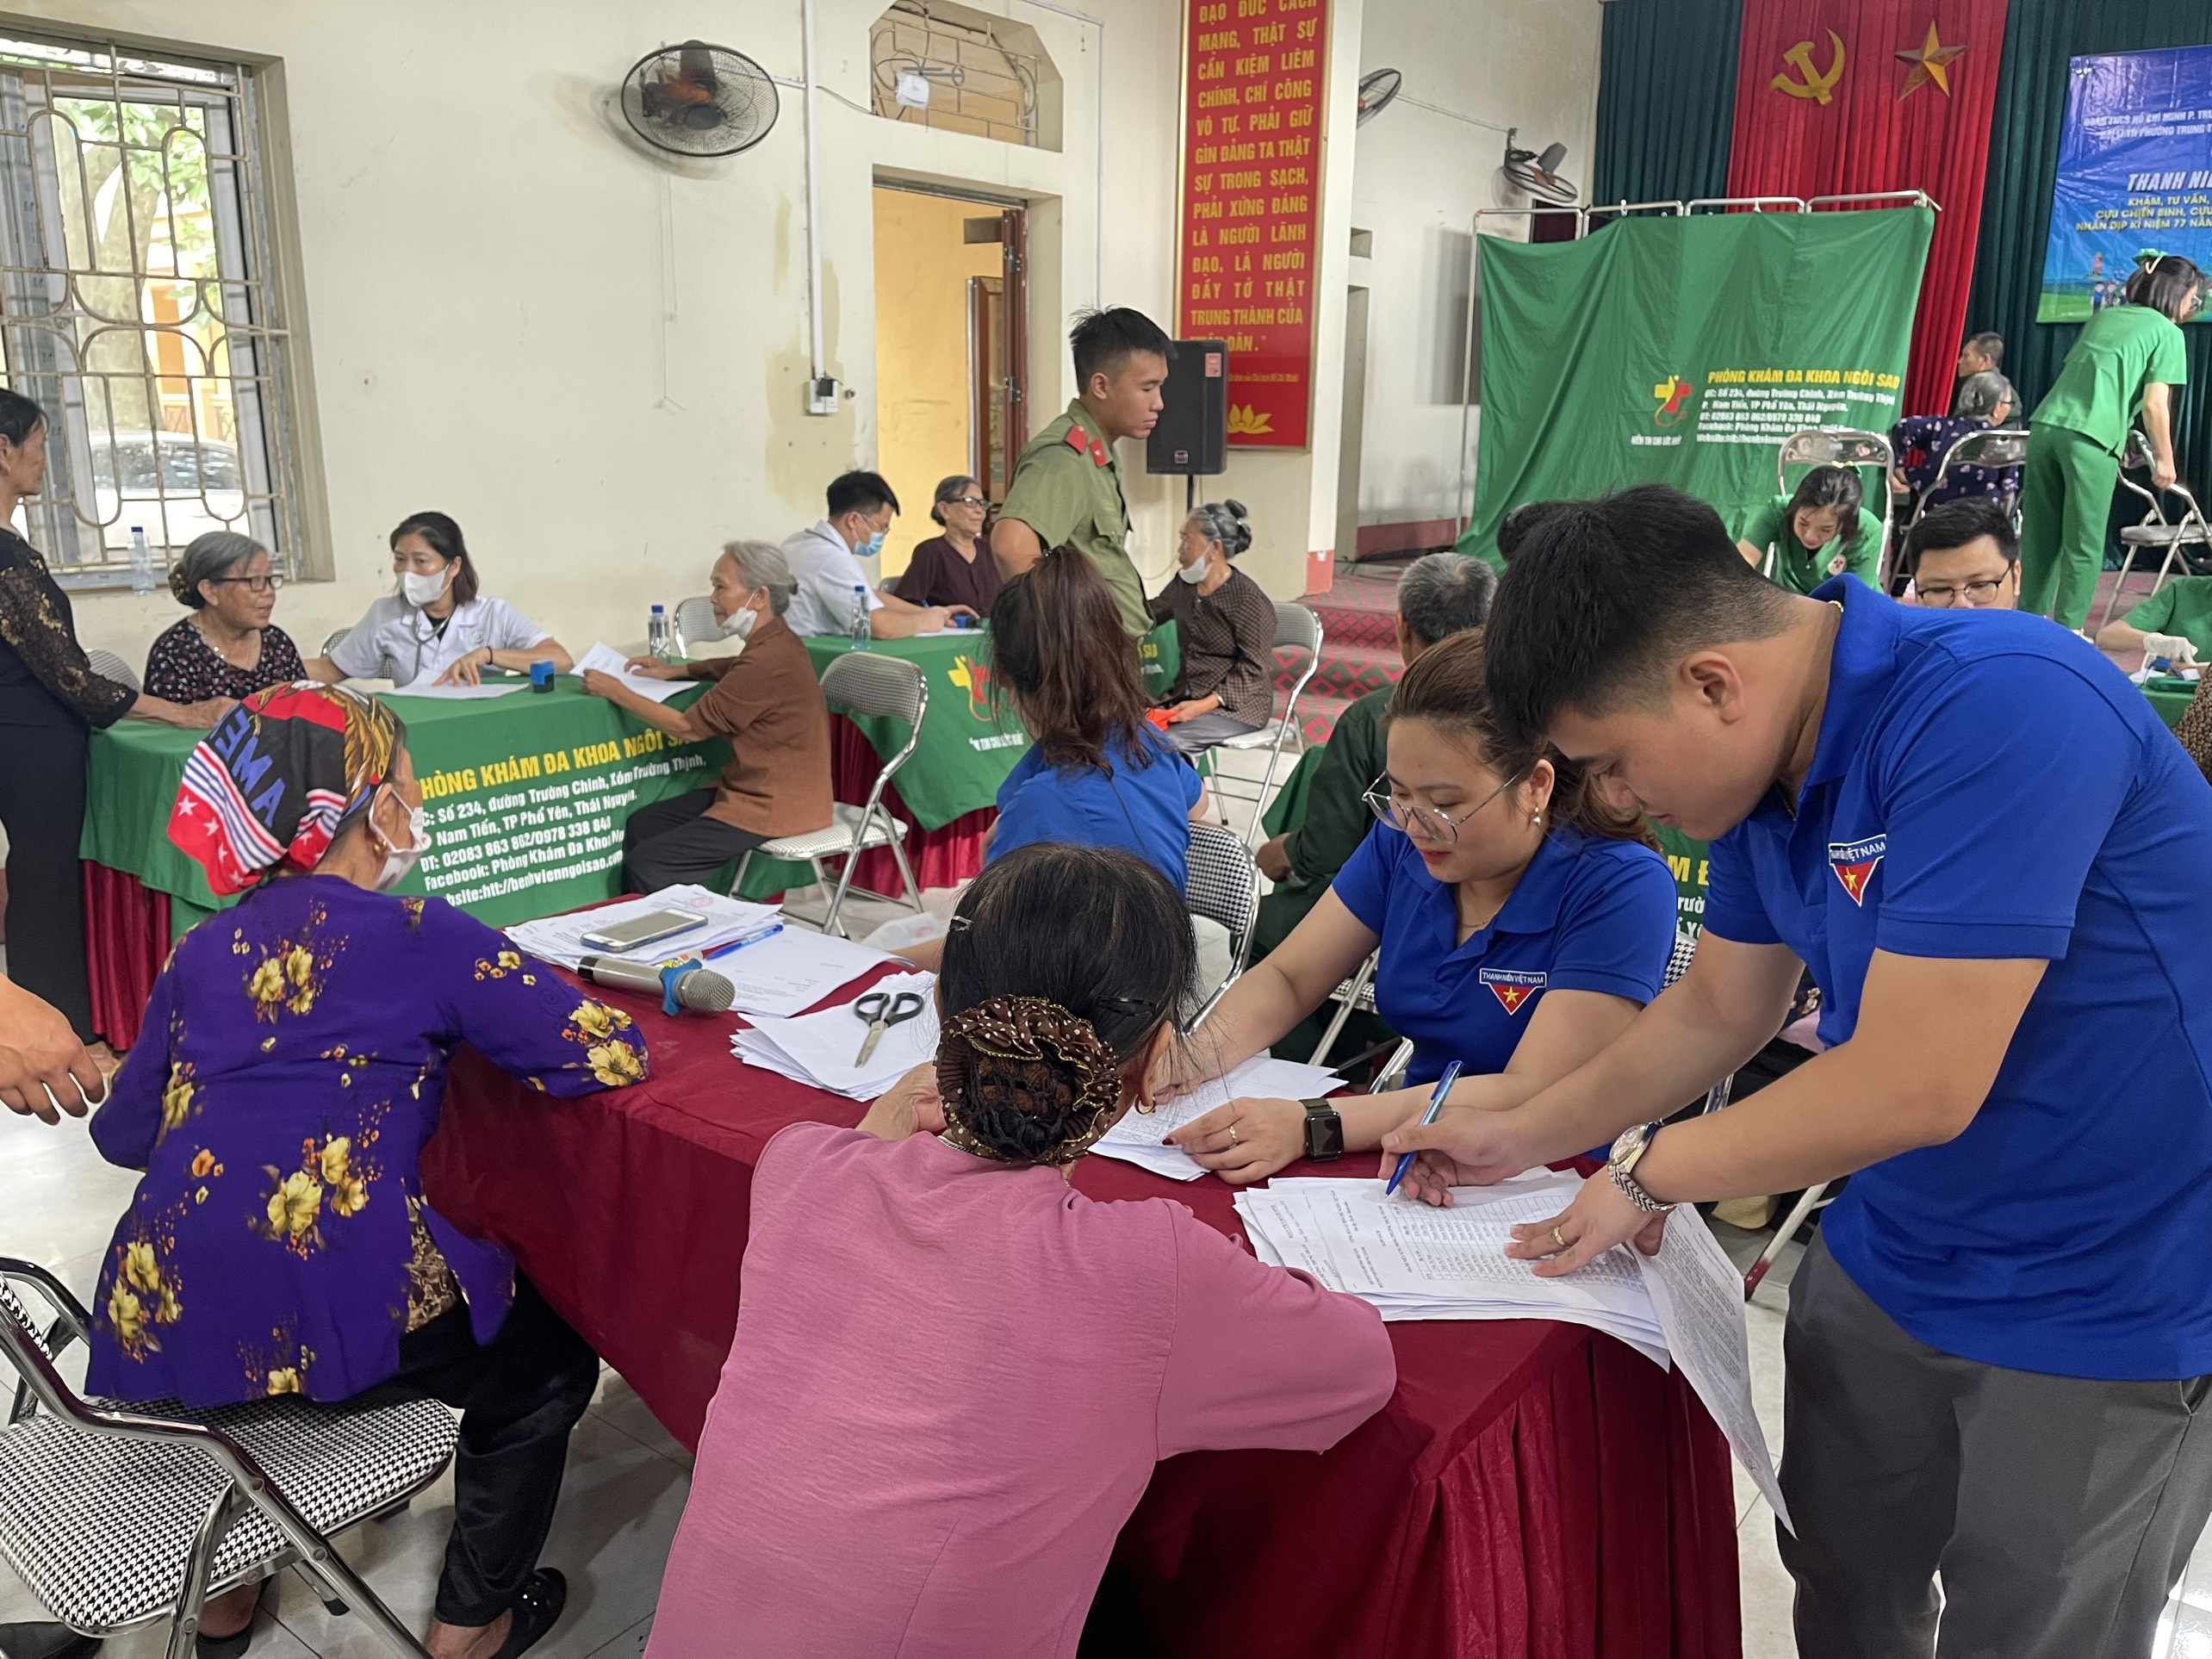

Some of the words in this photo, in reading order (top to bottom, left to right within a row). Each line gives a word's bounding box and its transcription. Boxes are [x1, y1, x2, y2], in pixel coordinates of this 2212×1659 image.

[1252, 21, 1286, 47] THẬT
[1297, 17, 1318, 41] SỰ
[1235, 53, 1270, 78] KIỆM
[1281, 47, 1314, 71] LIÊM
[1246, 81, 1268, 103] CHÍ
[1275, 78, 1312, 100] CÔNG
[1196, 115, 1213, 136] VÔ
[1249, 105, 1280, 131] PHẢI
[1289, 103, 1314, 127] GIỮ
[2162, 111, 2186, 121] MINH
[2188, 110, 2196, 120] P.
[2177, 124, 2205, 134] TRUNG
[1196, 142, 1217, 165] GÌN
[1221, 137, 1256, 162] ĐẢNG
[1258, 141, 1275, 159] TA
[1278, 134, 1310, 159] THẬT
[1195, 172, 1214, 196] SỰ
[1220, 171, 1261, 190] TRONG
[2128, 172, 2186, 190] THANH
[1193, 195, 1222, 220] PHẢI
[1229, 195, 1264, 217] XỨNG
[1271, 192, 1308, 214] ĐÁNG
[1192, 226, 1209, 246] LÀ
[1219, 222, 1260, 245] NGƯỜI
[1271, 221, 1307, 242] LÃNH
[2174, 218, 2187, 229] 77
[1234, 251, 1252, 271] LÀ
[1263, 247, 1305, 270] NGƯỜI
[1265, 276, 1305, 301] THẬT
[1190, 309, 1231, 326] TRUNG
[1233, 305, 1275, 326] THÀNH
[1277, 301, 1303, 325] CỦA
[1708, 368, 1746, 384] PHÒNG
[1748, 368, 1784, 383] KHÁM
[1805, 370, 1840, 384] KHOA
[1843, 370, 1875, 387] NGÔI
[1876, 373, 1900, 389] SAO
[419, 767, 478, 800] HÒNG
[480, 755, 540, 787] KHÁM
[543, 750, 570, 775] ĐA
[572, 740, 622, 769] KHOA
[623, 728, 664, 759] NGÔI
[422, 811, 435, 827] C:
[437, 803, 455, 824] Số
[457, 800, 487, 820] 234,
[488, 792, 525, 812] đường
[528, 785, 570, 804] Trường
[610, 771, 633, 787] Xóm
[436, 828, 468, 847] Nam
[469, 818, 501, 838] Tiến,
[502, 815, 518, 830] TP
[547, 805, 574, 823] Yên,
[574, 797, 600, 817] Thái
[442, 844, 483, 867] 02083
[485, 838, 509, 858] 863
[568, 821, 590, 839] 338
[1860, 842, 1886, 858] NAM
[424, 864, 489, 892] Facebook:
[491, 854, 528, 875] Phòng
[529, 845, 566, 864] Khám
